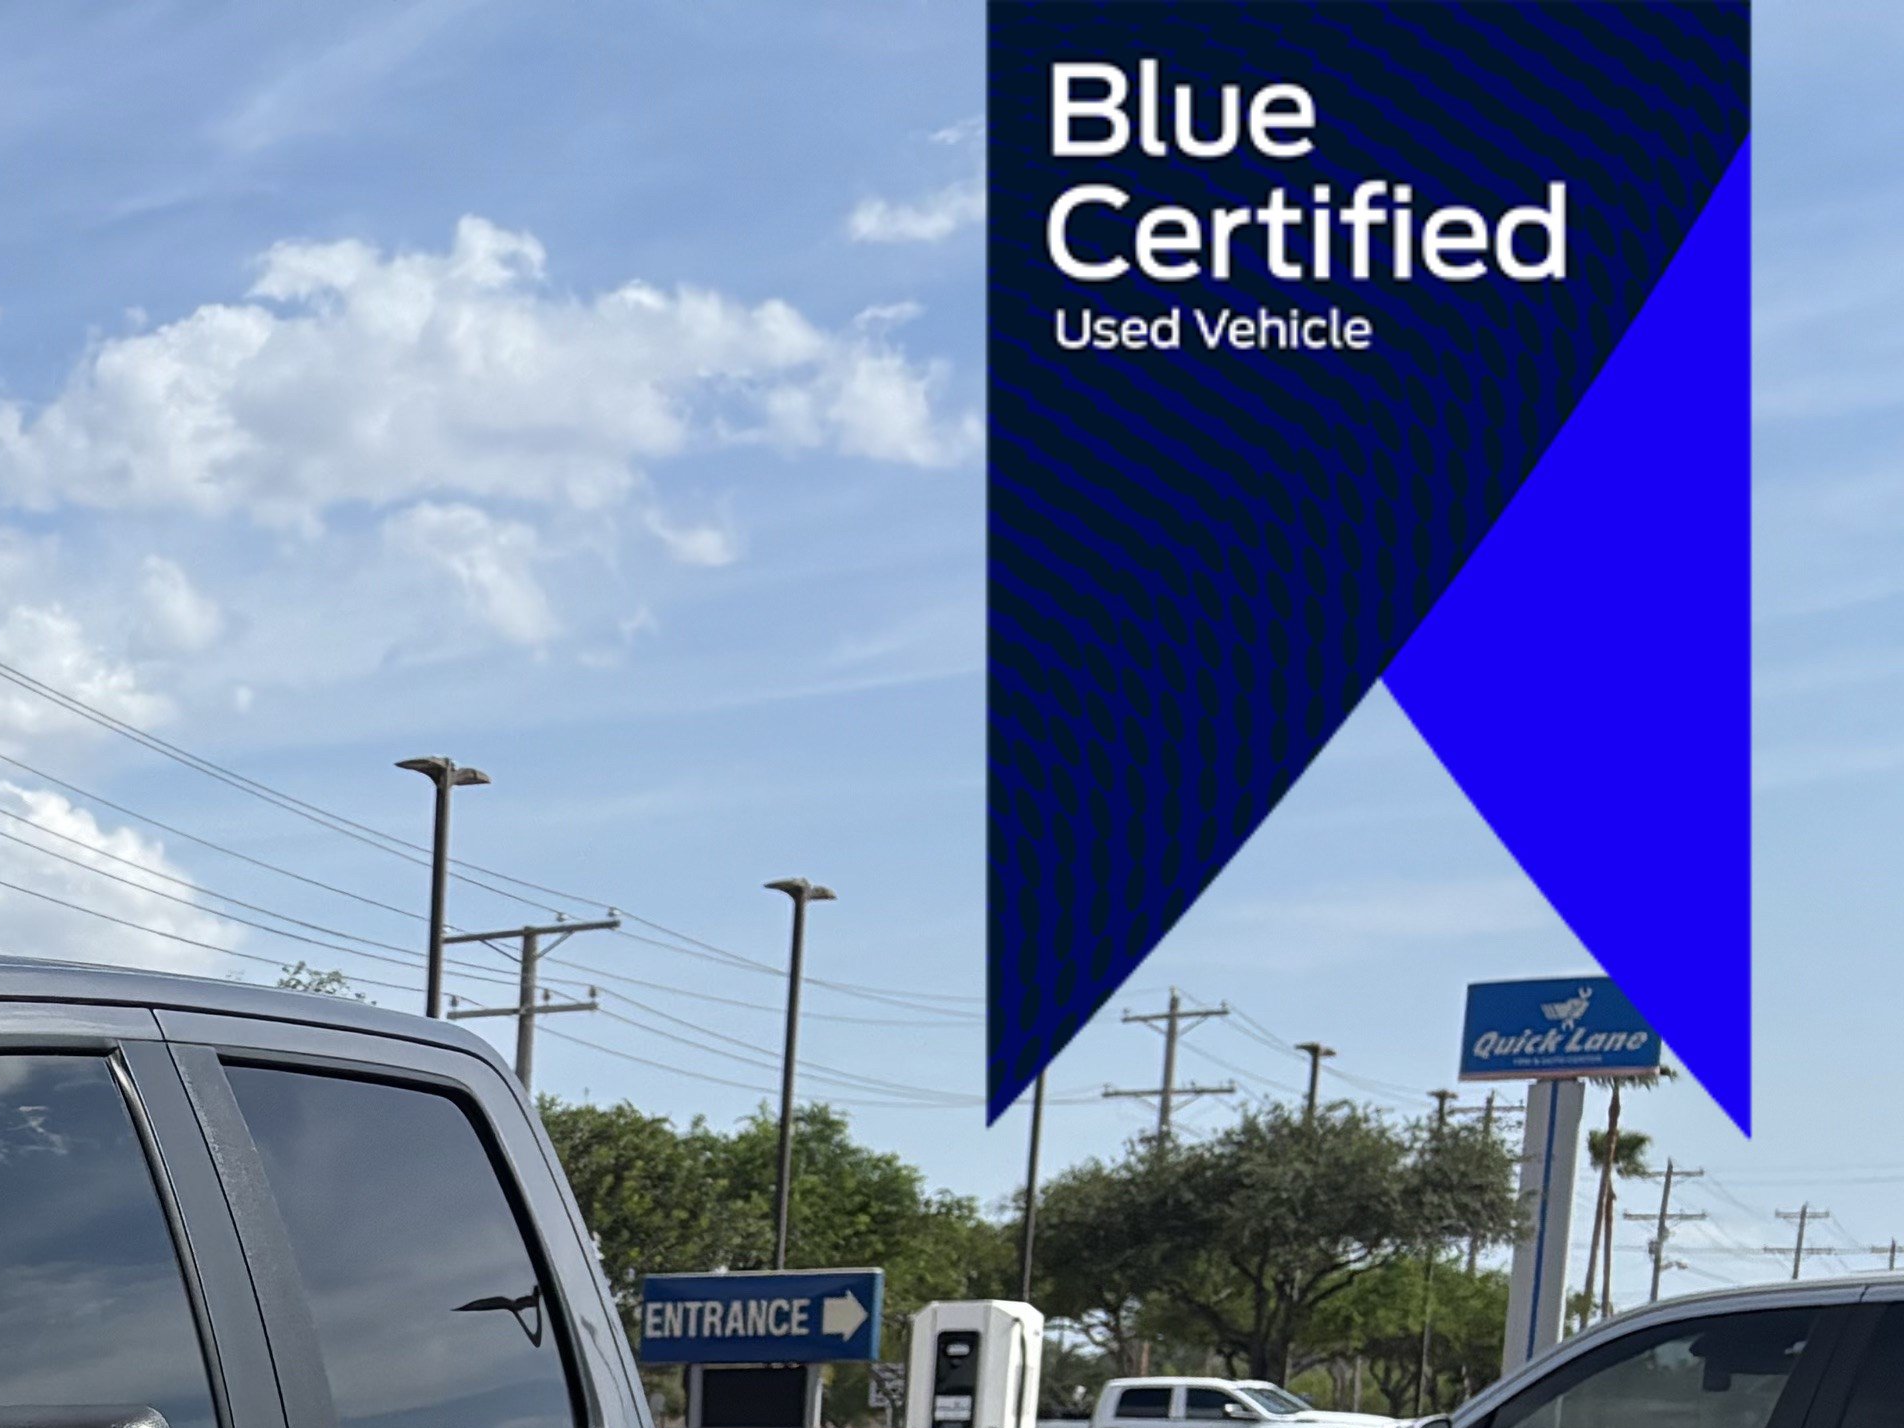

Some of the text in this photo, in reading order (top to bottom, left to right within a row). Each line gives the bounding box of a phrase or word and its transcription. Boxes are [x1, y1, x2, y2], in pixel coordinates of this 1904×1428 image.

[1473, 1026, 1649, 1060] Quick Lane
[644, 1298, 811, 1339] ENTRANCE
